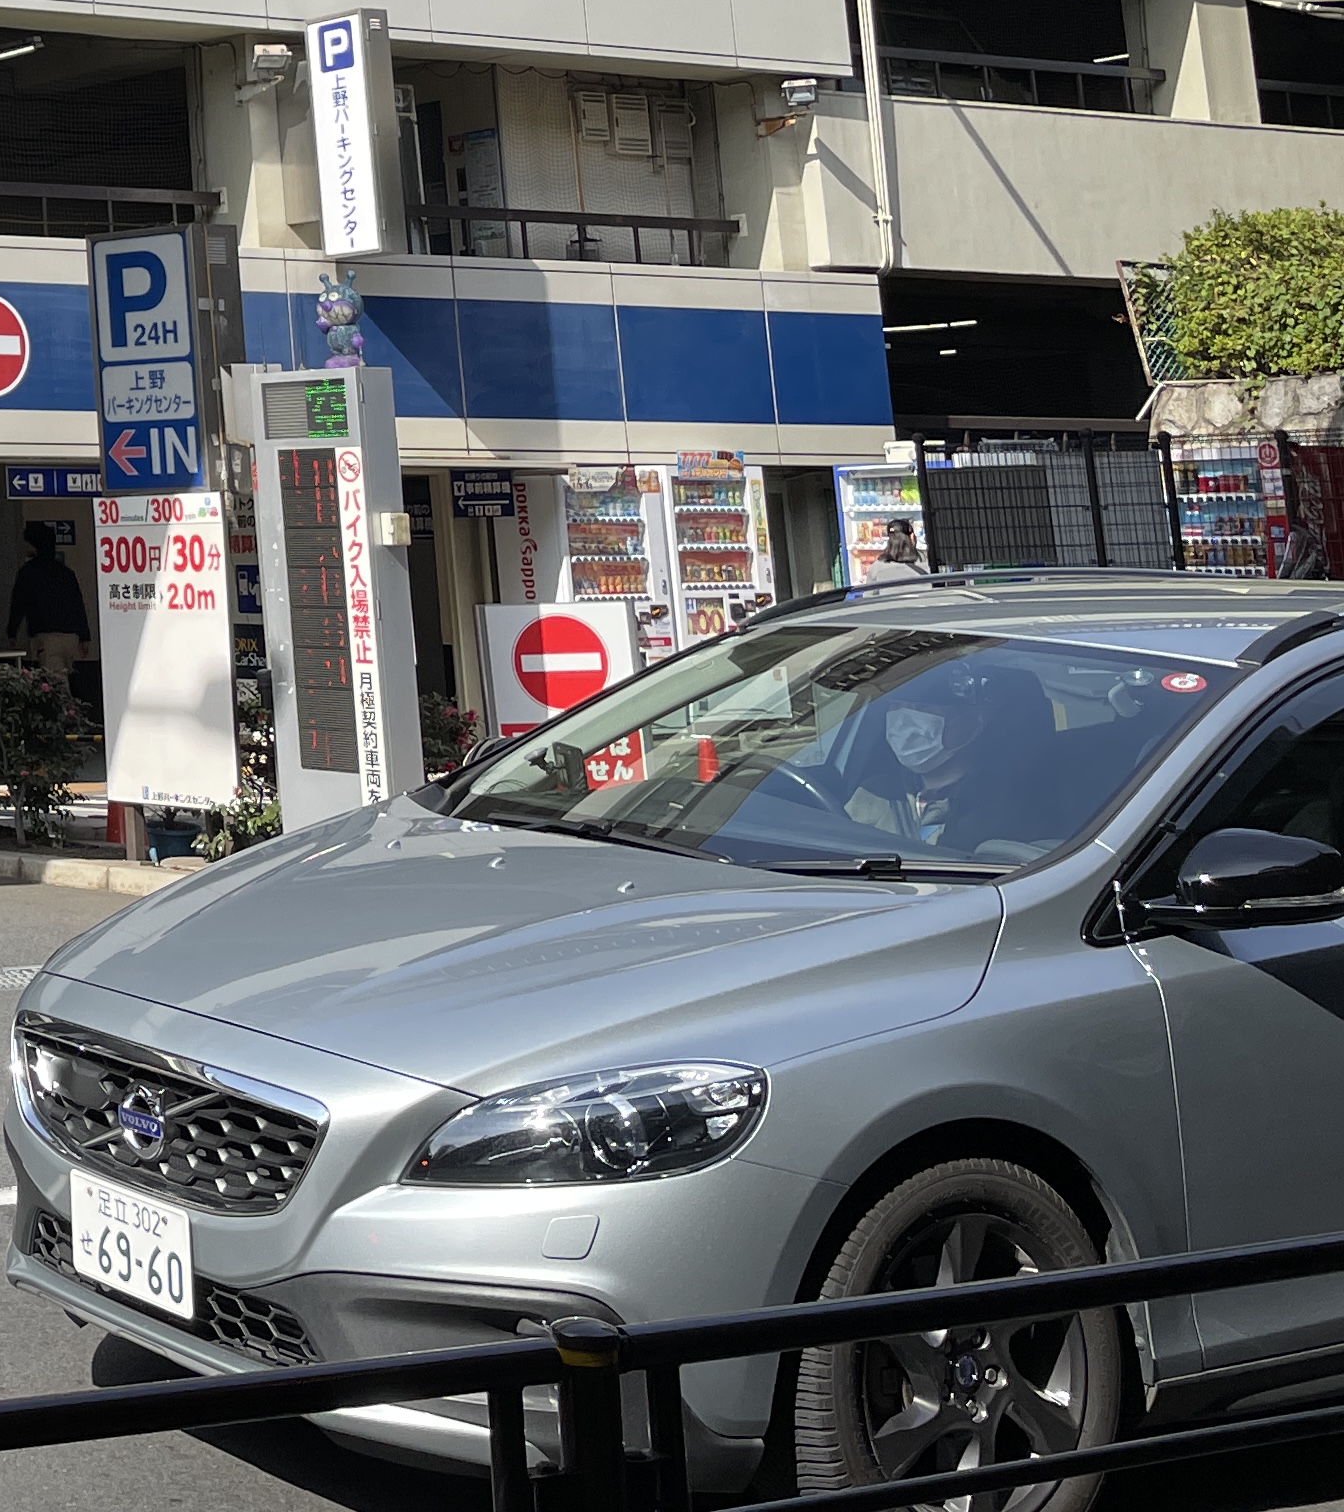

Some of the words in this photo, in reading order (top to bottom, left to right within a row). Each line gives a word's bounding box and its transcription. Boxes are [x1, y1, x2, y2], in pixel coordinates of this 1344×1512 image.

[323, 25, 350, 67] P
[331, 73, 358, 249] 上野パーキングセンター
[105, 250, 168, 348] P
[133, 320, 179, 347] 24H
[130, 369, 166, 392] 上野
[106, 393, 192, 416] パーキングセンター
[149, 425, 199, 476] IN
[98, 500, 119, 524] 30
[512, 482, 531, 537] pokka
[100, 534, 221, 573] 300円/30分
[519, 538, 538, 600] sappo
[344, 488, 374, 665] バイク入場禁止
[109, 583, 156, 600] 高さ制限
[167, 583, 216, 610] 2.0m
[109, 601, 137, 613] Height
[234, 652, 266, 667] CarSha
[587, 759, 634, 781] せん
[121, 1111, 159, 1133] VOLVO
[98, 1188, 129, 1226] 足立
[132, 1202, 162, 1238] 302
[98, 1225, 184, 1304] 69-60
